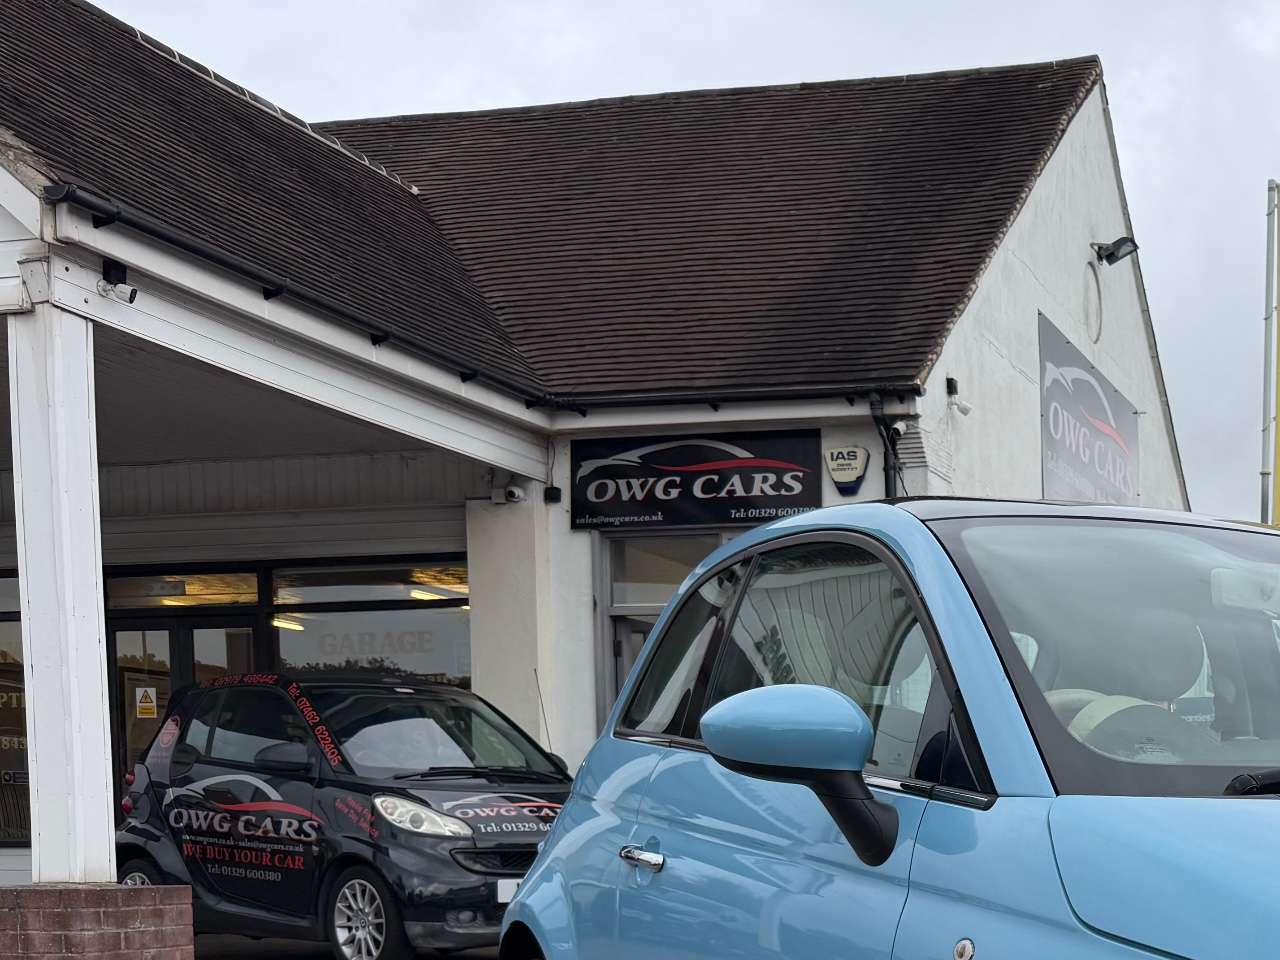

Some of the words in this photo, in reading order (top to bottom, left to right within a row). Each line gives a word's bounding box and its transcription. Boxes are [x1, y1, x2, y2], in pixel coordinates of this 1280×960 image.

[831, 450, 857, 461] IAS
[1049, 401, 1090, 465] OWG
[1094, 440, 1134, 499] CARS
[586, 475, 682, 502] OWG
[692, 471, 804, 499] CARS
[576, 511, 664, 526] sales@owgcars.co.uk
[730, 509, 747, 519] Tel:
[748, 508, 776, 518] 01329
[319, 631, 434, 655] GARAGE
[287, 681, 300, 699] Tel:
[296, 697, 321, 726] 07462
[314, 724, 343, 769] 622405
[455, 806, 518, 818] OWG
[168, 807, 232, 833] OWG
[237, 814, 320, 842] CARS
[478, 823, 500, 833] Tel:
[502, 822, 537, 832] 01329
[182, 842, 203, 857] WE
[206, 845, 232, 861] BUY
[234, 848, 272, 866] YOUR
[275, 853, 305, 870] CAR
[207, 863, 221, 874] Tel:
[221, 866, 245, 877] 01329
[246, 870, 282, 882] 600380
